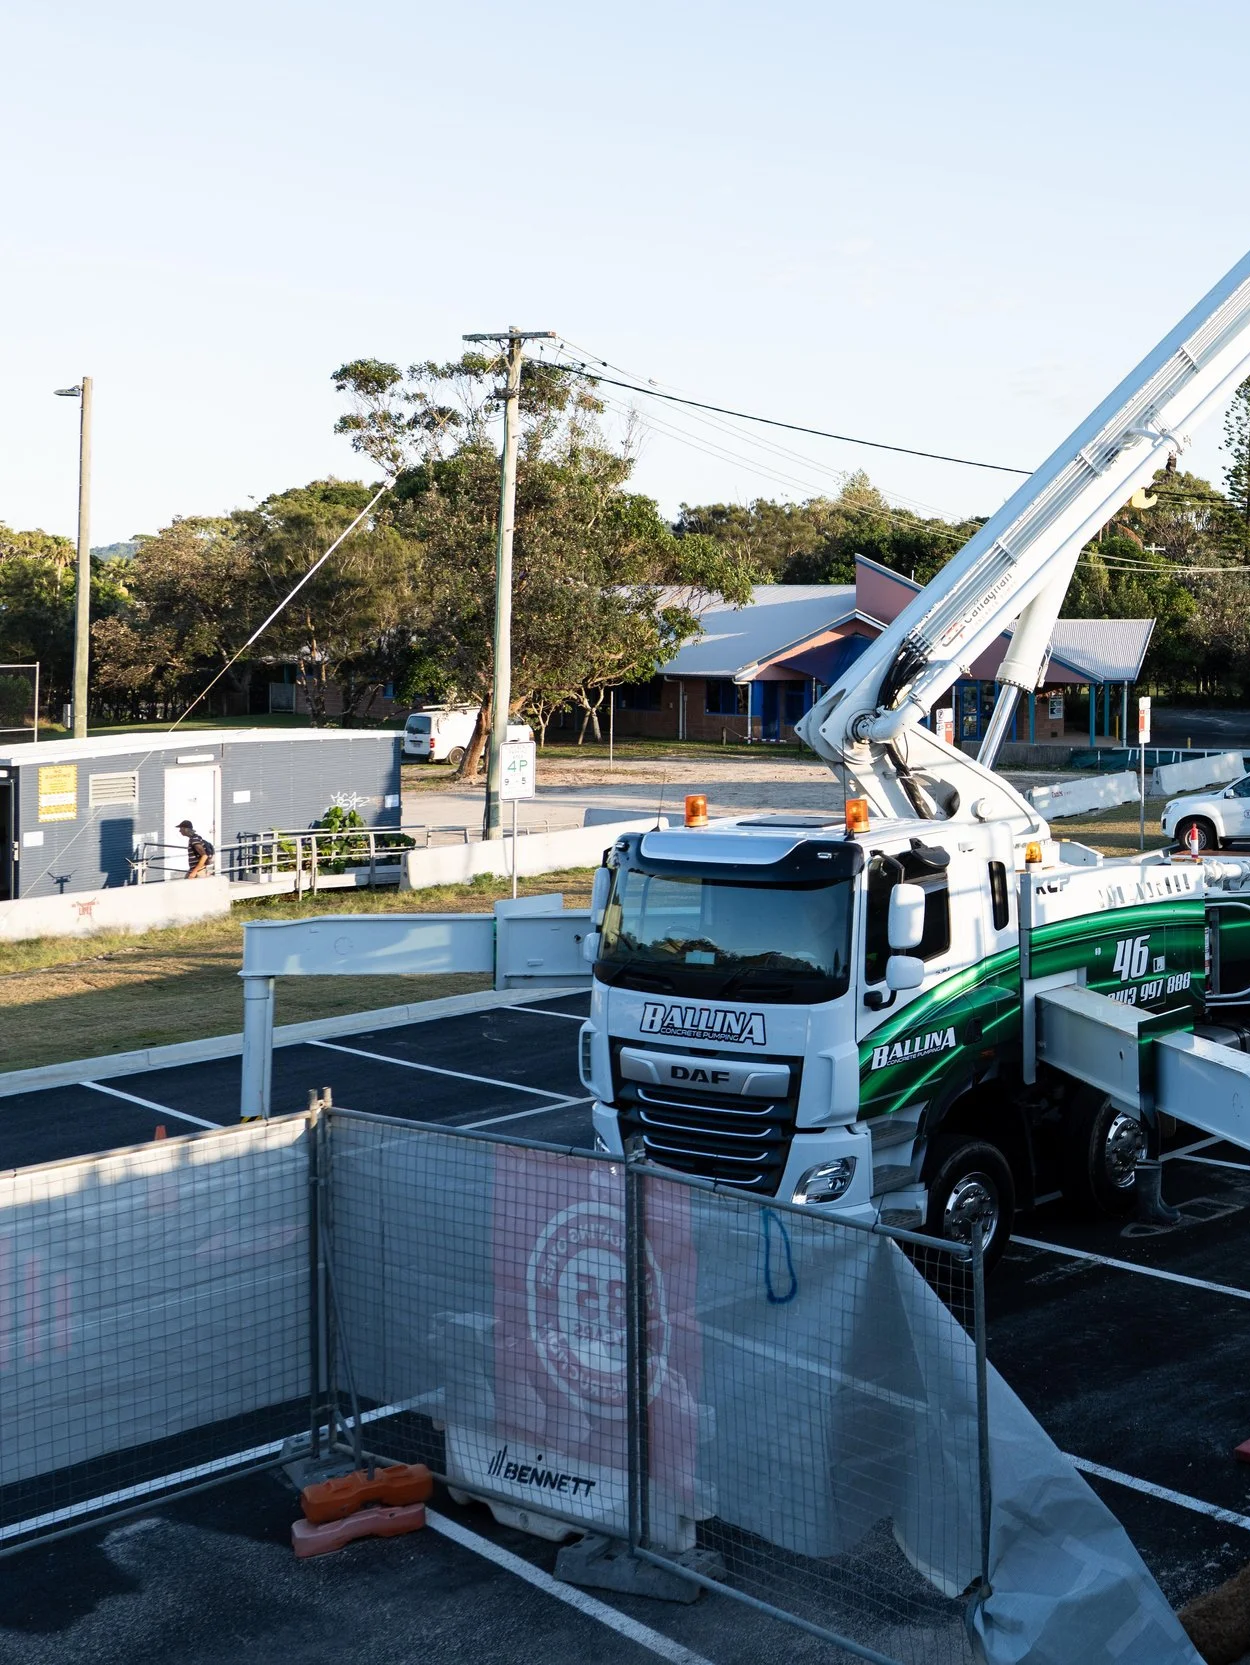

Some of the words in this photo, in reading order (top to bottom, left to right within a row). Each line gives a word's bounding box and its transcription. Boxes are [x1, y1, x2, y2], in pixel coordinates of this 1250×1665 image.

[507, 759, 528, 772] 4P
[1113, 934, 1150, 982] 46
[1140, 980, 1163, 1002] 997
[1166, 972, 1191, 994] 888
[640, 1002, 766, 1046] BALLINA
[660, 1026, 702, 1038] CONCRETE
[702, 1032, 740, 1042] PUMPING
[871, 1026, 956, 1070] BALLINA
[886, 1053, 916, 1066] CONCRETE
[916, 1046, 941, 1058] PUMPING
[671, 1065, 730, 1084] DAF
[504, 1461, 596, 1498] BENNETT
